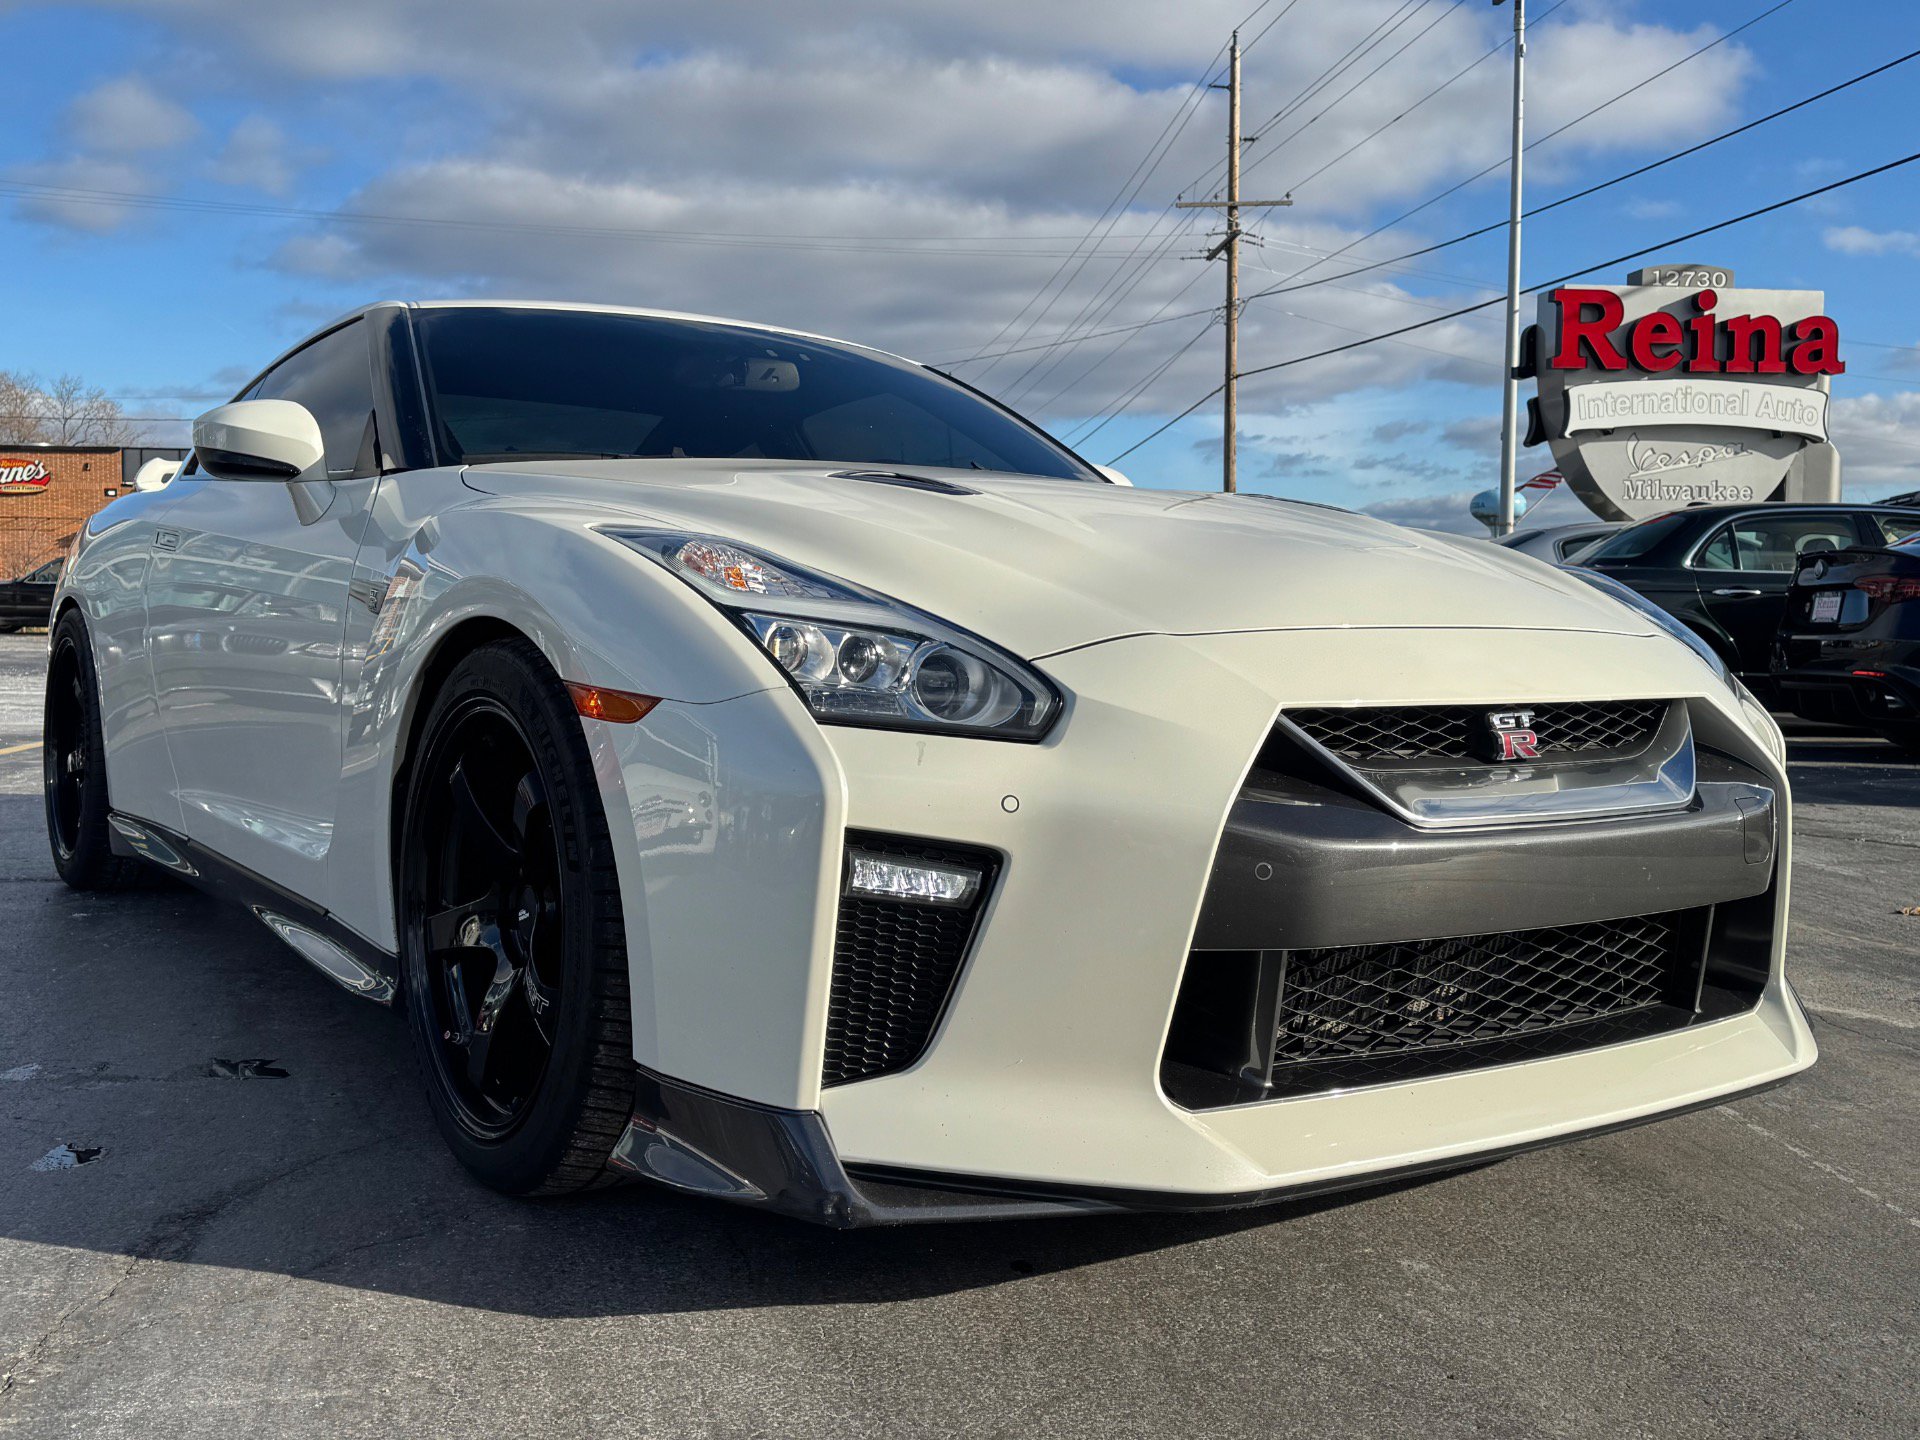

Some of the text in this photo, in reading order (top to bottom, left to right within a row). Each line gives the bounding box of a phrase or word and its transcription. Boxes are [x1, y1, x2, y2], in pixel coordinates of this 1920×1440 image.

[1652, 270, 1727, 288] 12730
[1551, 288, 1845, 375] Reina
[1578, 386, 1819, 427] International Auto
[0, 459, 49, 483] ane's
[1626, 432, 1753, 478] Vespa
[1622, 479, 1753, 501] Milwaukee
